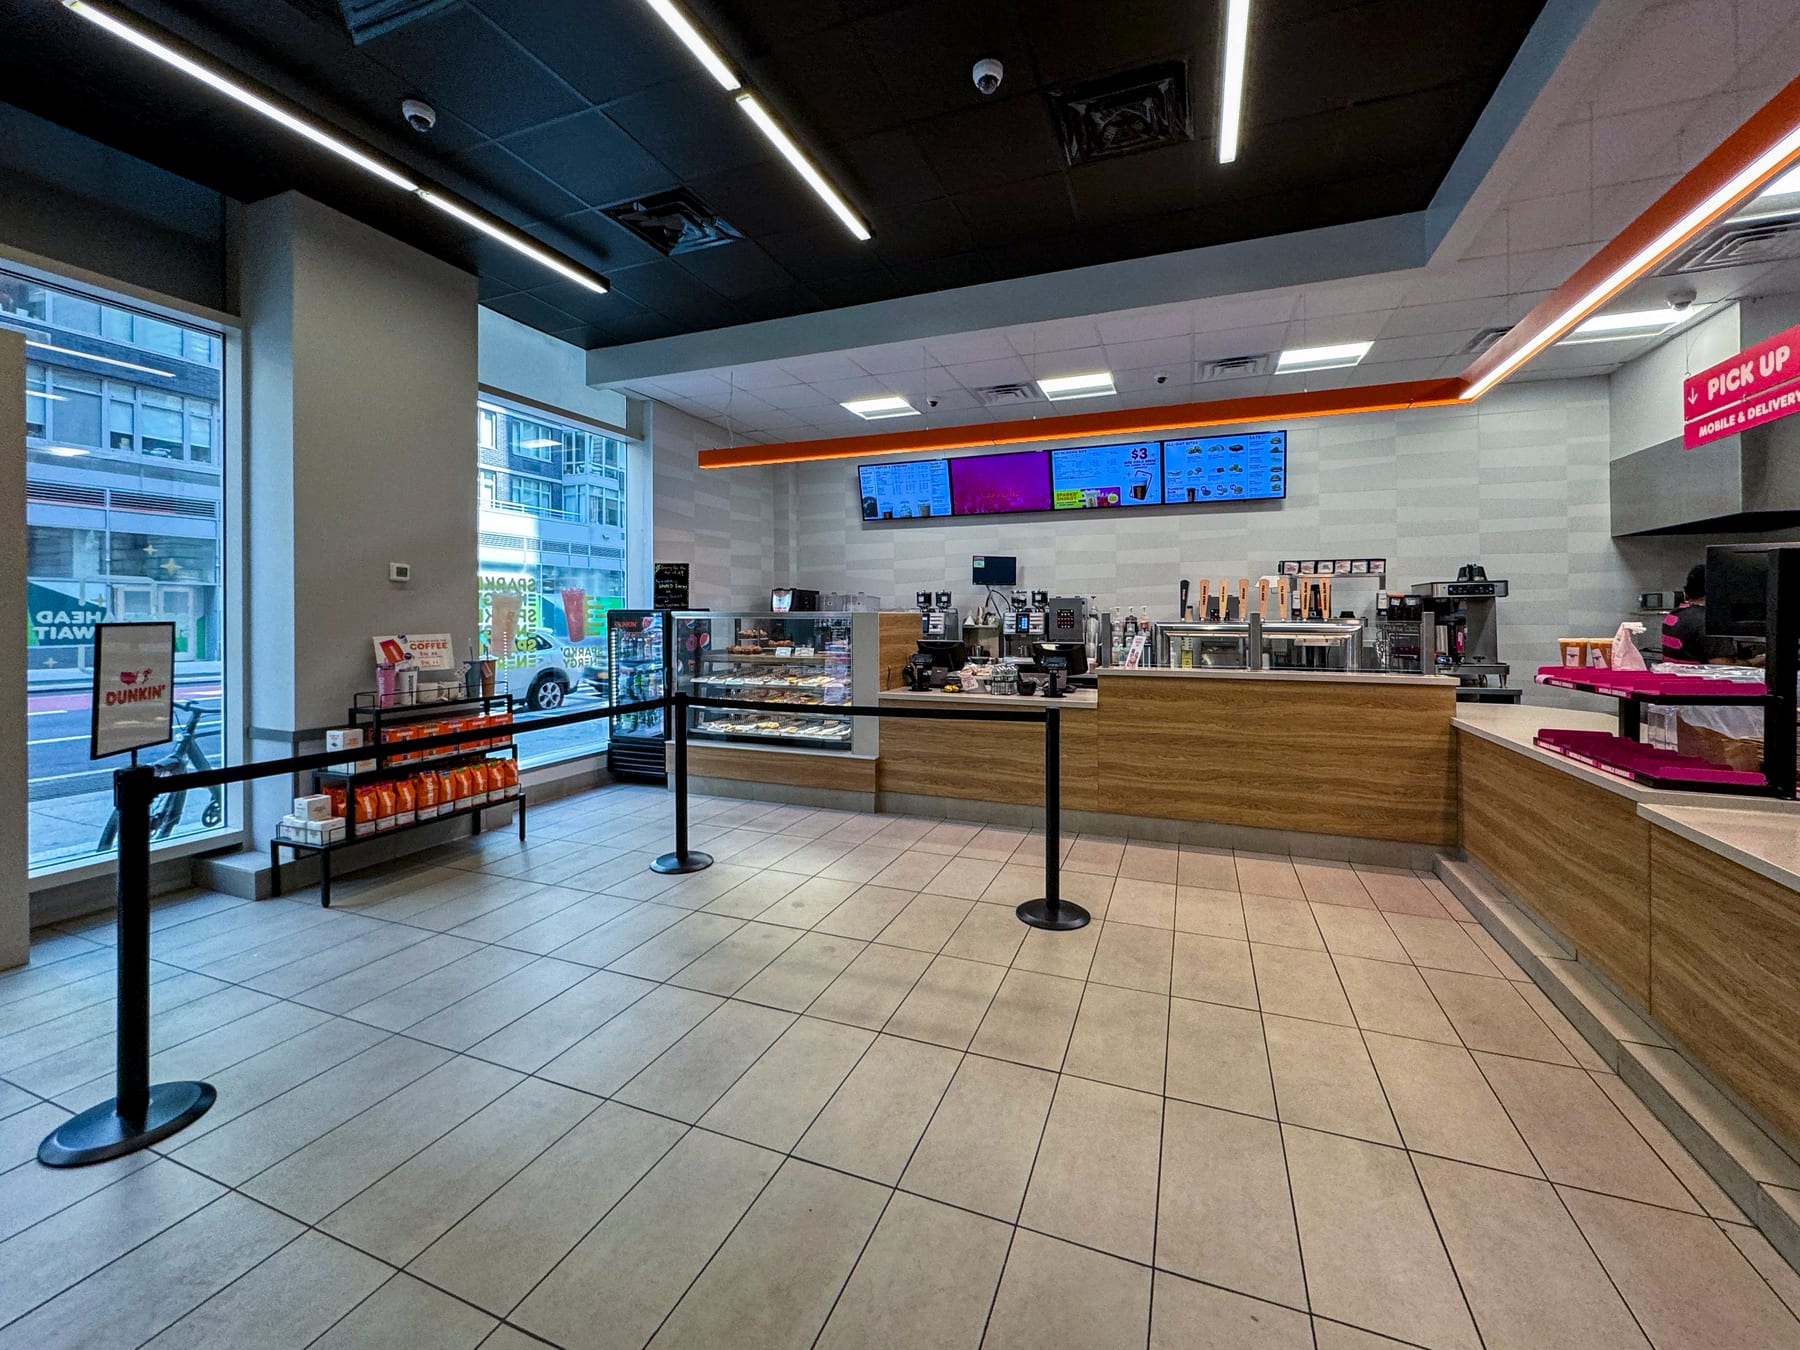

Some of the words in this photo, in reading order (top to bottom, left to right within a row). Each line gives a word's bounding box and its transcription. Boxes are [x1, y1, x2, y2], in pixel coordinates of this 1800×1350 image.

[1707, 360, 1754, 401] PICK
[1759, 345, 1791, 377] UP
[1698, 414, 1736, 438] MOBILE
[1737, 411, 1746, 423] &
[1131, 447, 1148, 460] $3
[409, 642, 448, 651] COFFEE
[105, 684, 166, 706] DUNKIN'
